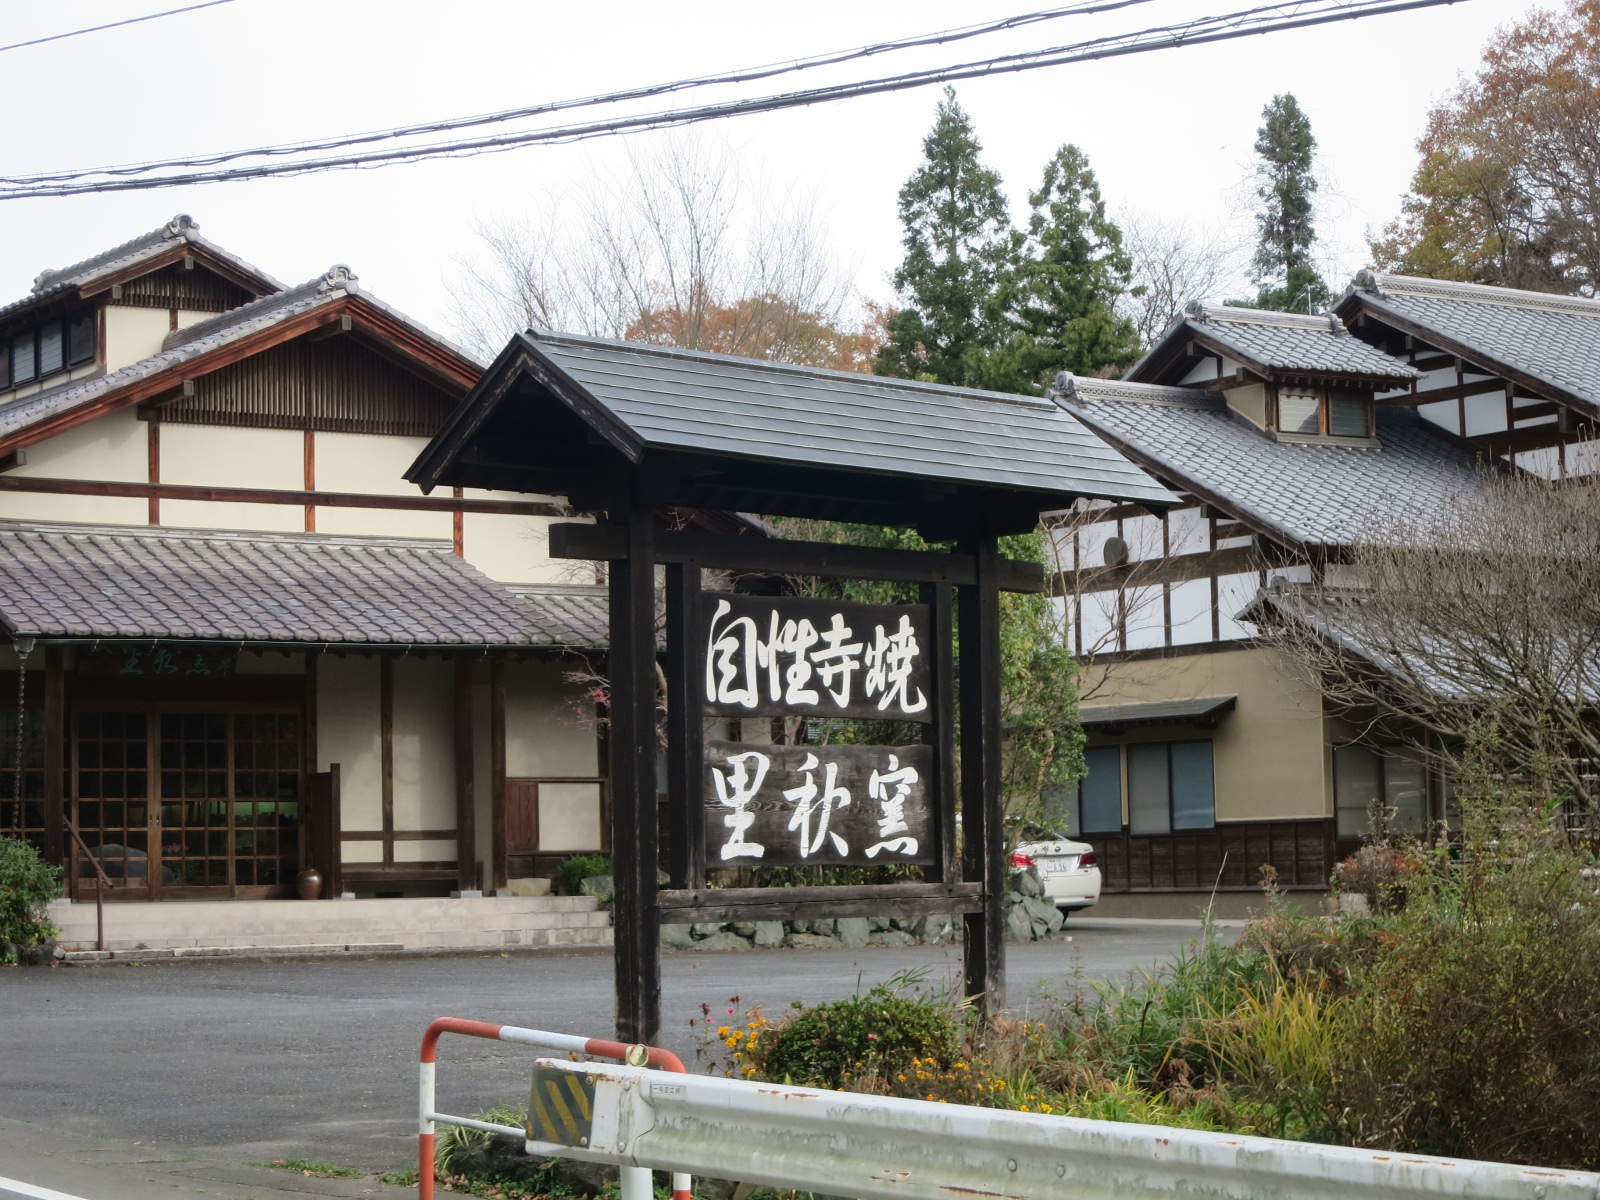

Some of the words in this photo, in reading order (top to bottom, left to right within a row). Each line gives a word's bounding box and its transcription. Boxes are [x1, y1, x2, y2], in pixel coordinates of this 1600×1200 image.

[706, 599, 928, 713] 自性寺焼
[711, 751, 919, 860] 里秋窯
